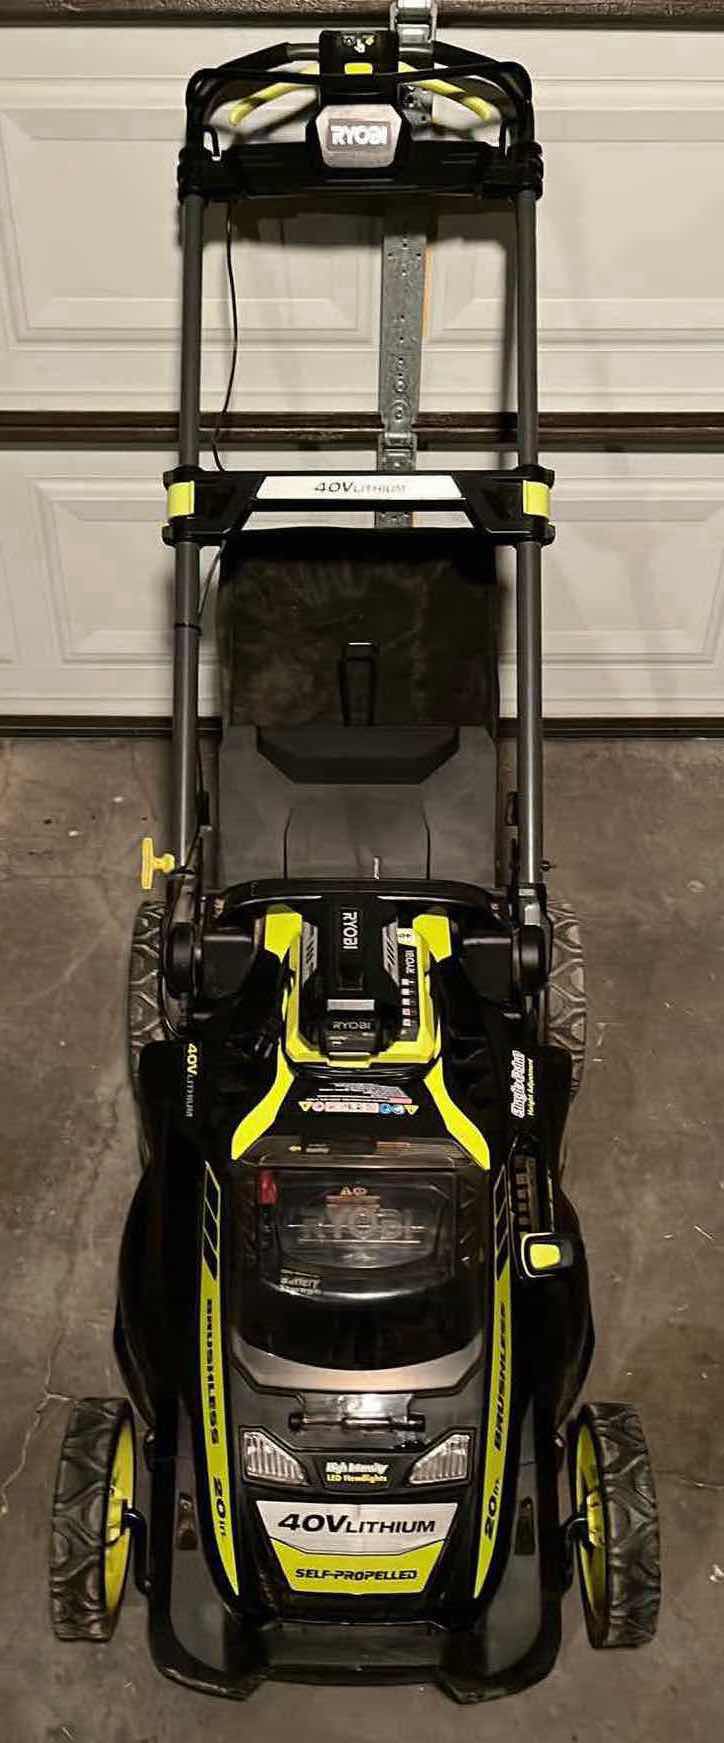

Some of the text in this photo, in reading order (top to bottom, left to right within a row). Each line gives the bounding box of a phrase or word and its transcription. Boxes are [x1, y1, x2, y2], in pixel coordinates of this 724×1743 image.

[331, 125, 387, 145] RYOBI
[342, 911, 359, 950] RYOBI
[295, 1568, 418, 1581] SELF-PROPELLED
